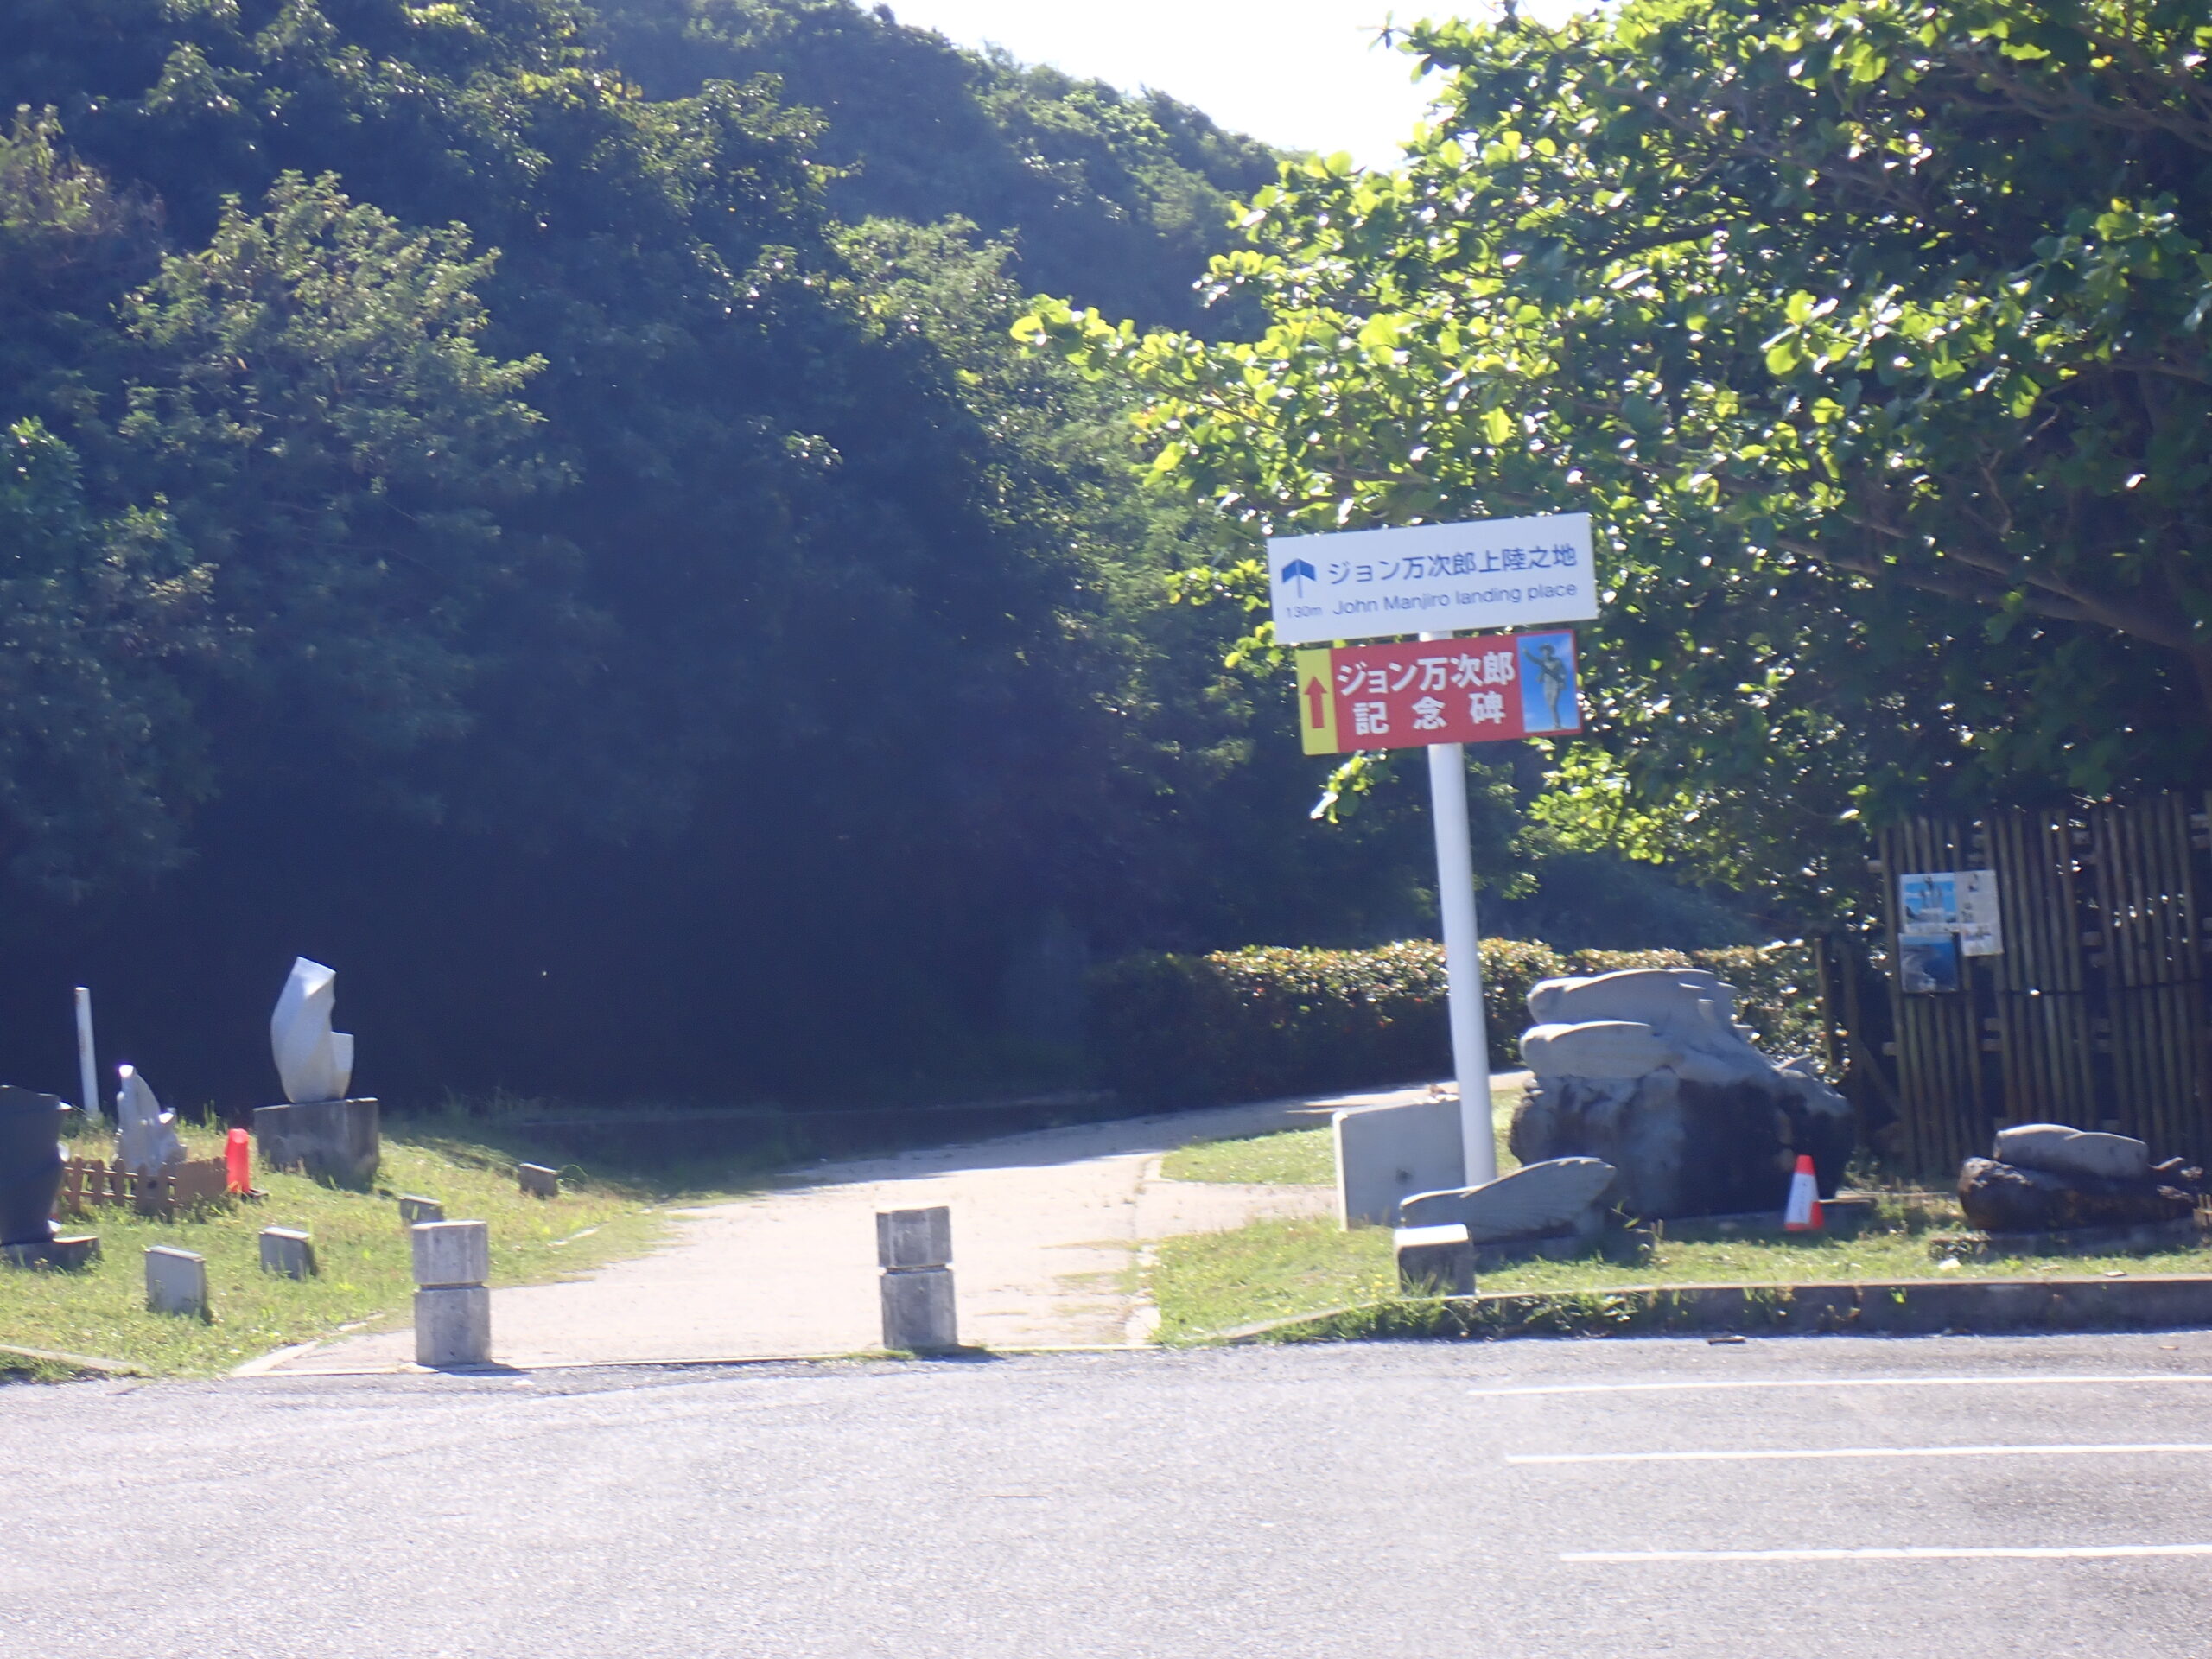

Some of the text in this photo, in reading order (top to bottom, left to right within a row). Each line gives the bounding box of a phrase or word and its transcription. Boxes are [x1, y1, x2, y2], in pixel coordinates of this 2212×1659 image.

[1328, 543, 1577, 585] ジョン万次郎上陸之地
[1286, 606, 1323, 620] 130m
[1333, 582, 1578, 615] John Manjiro landing place
[1337, 651, 1516, 696] ジョン万次郎
